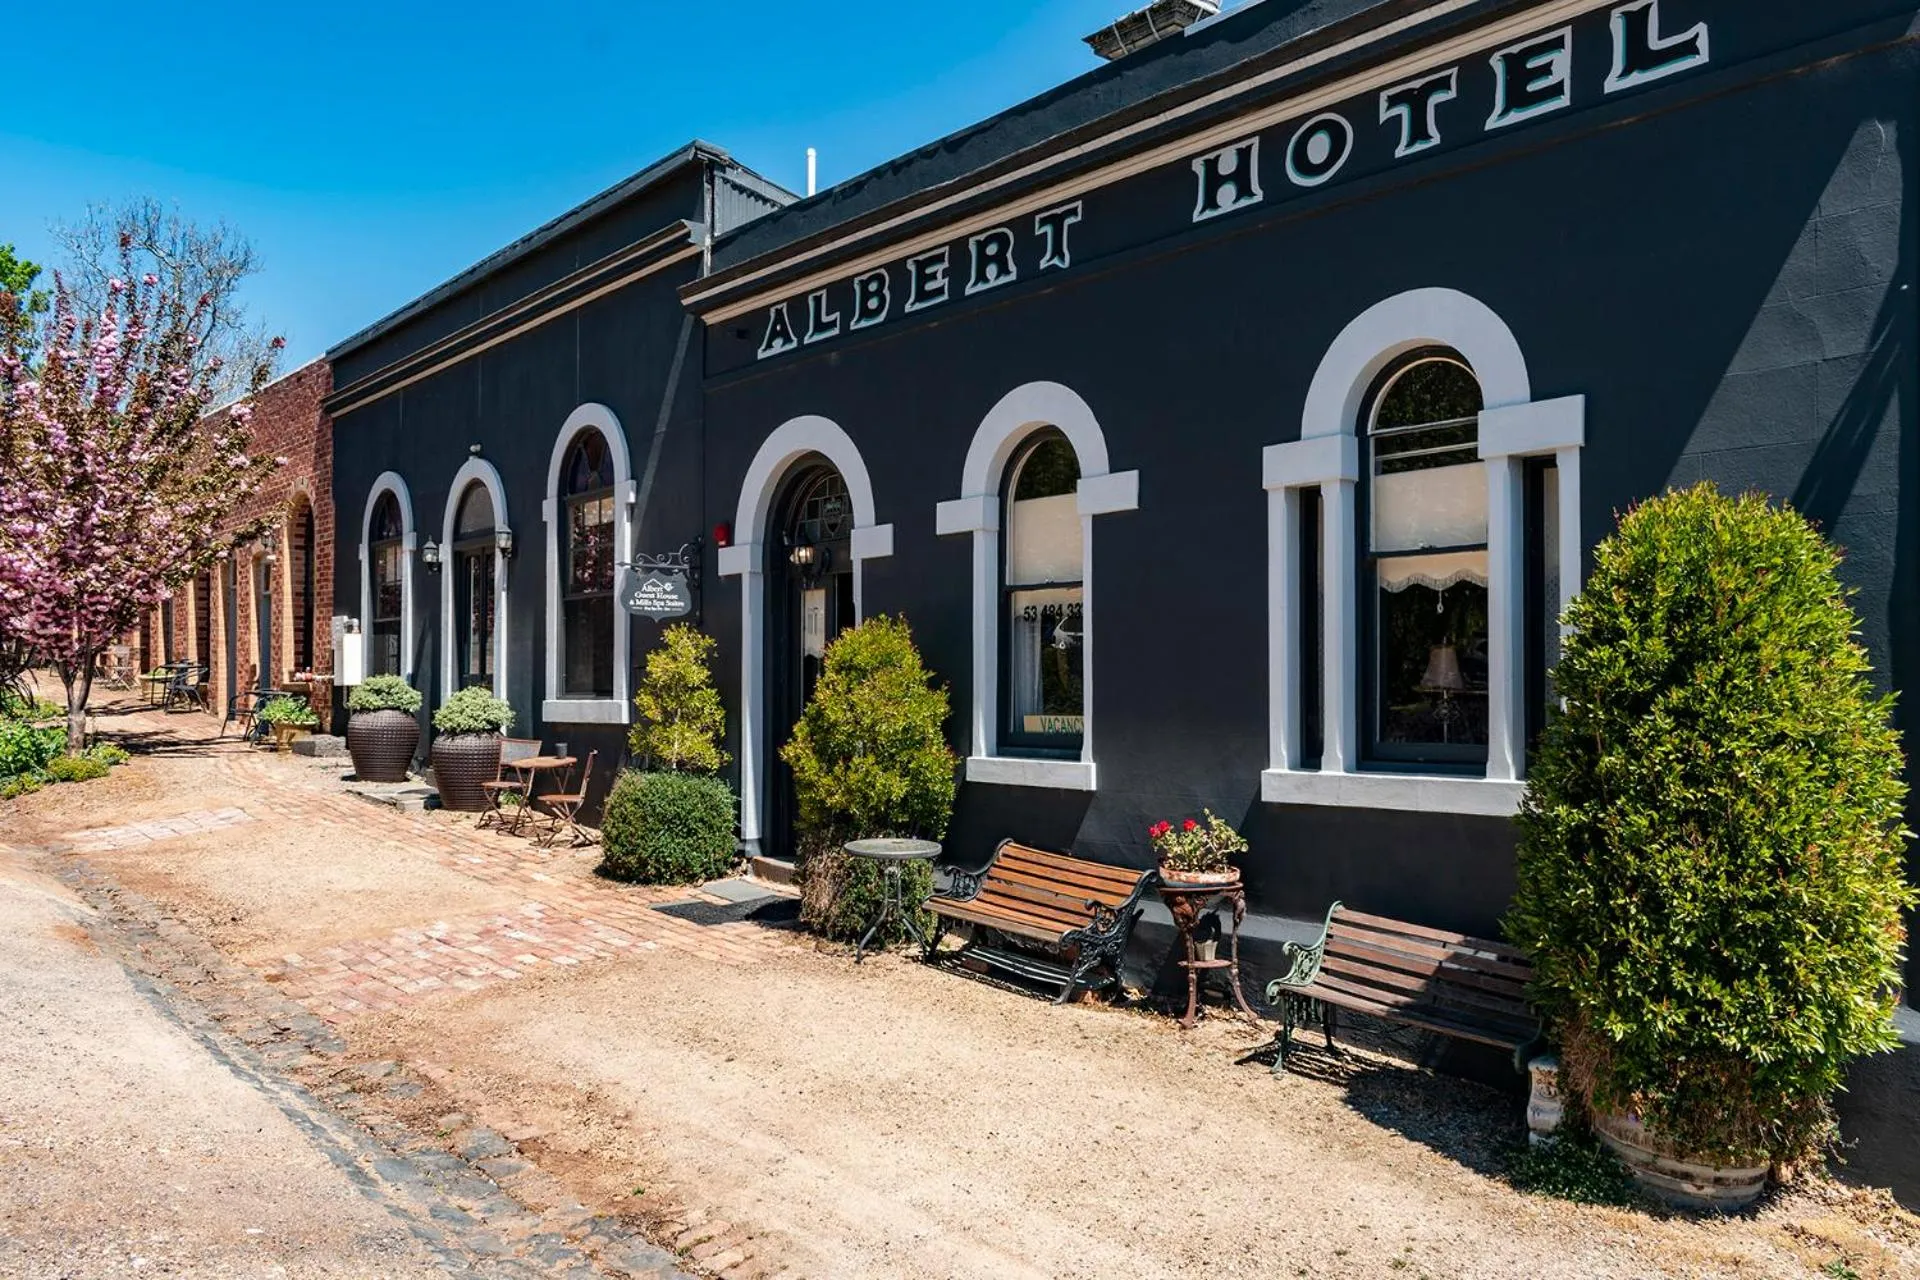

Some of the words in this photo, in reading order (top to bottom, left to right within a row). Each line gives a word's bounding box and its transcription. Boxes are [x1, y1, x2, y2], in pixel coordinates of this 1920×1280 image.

[757, 200, 1083, 360] ALBERT
[1192, 0, 1710, 223] HOTEL
[634, 591, 655, 599] Guest
[653, 599, 665, 608] Spa
[1023, 605, 1038, 622] 53
[1067, 602, 1083, 620] 33
